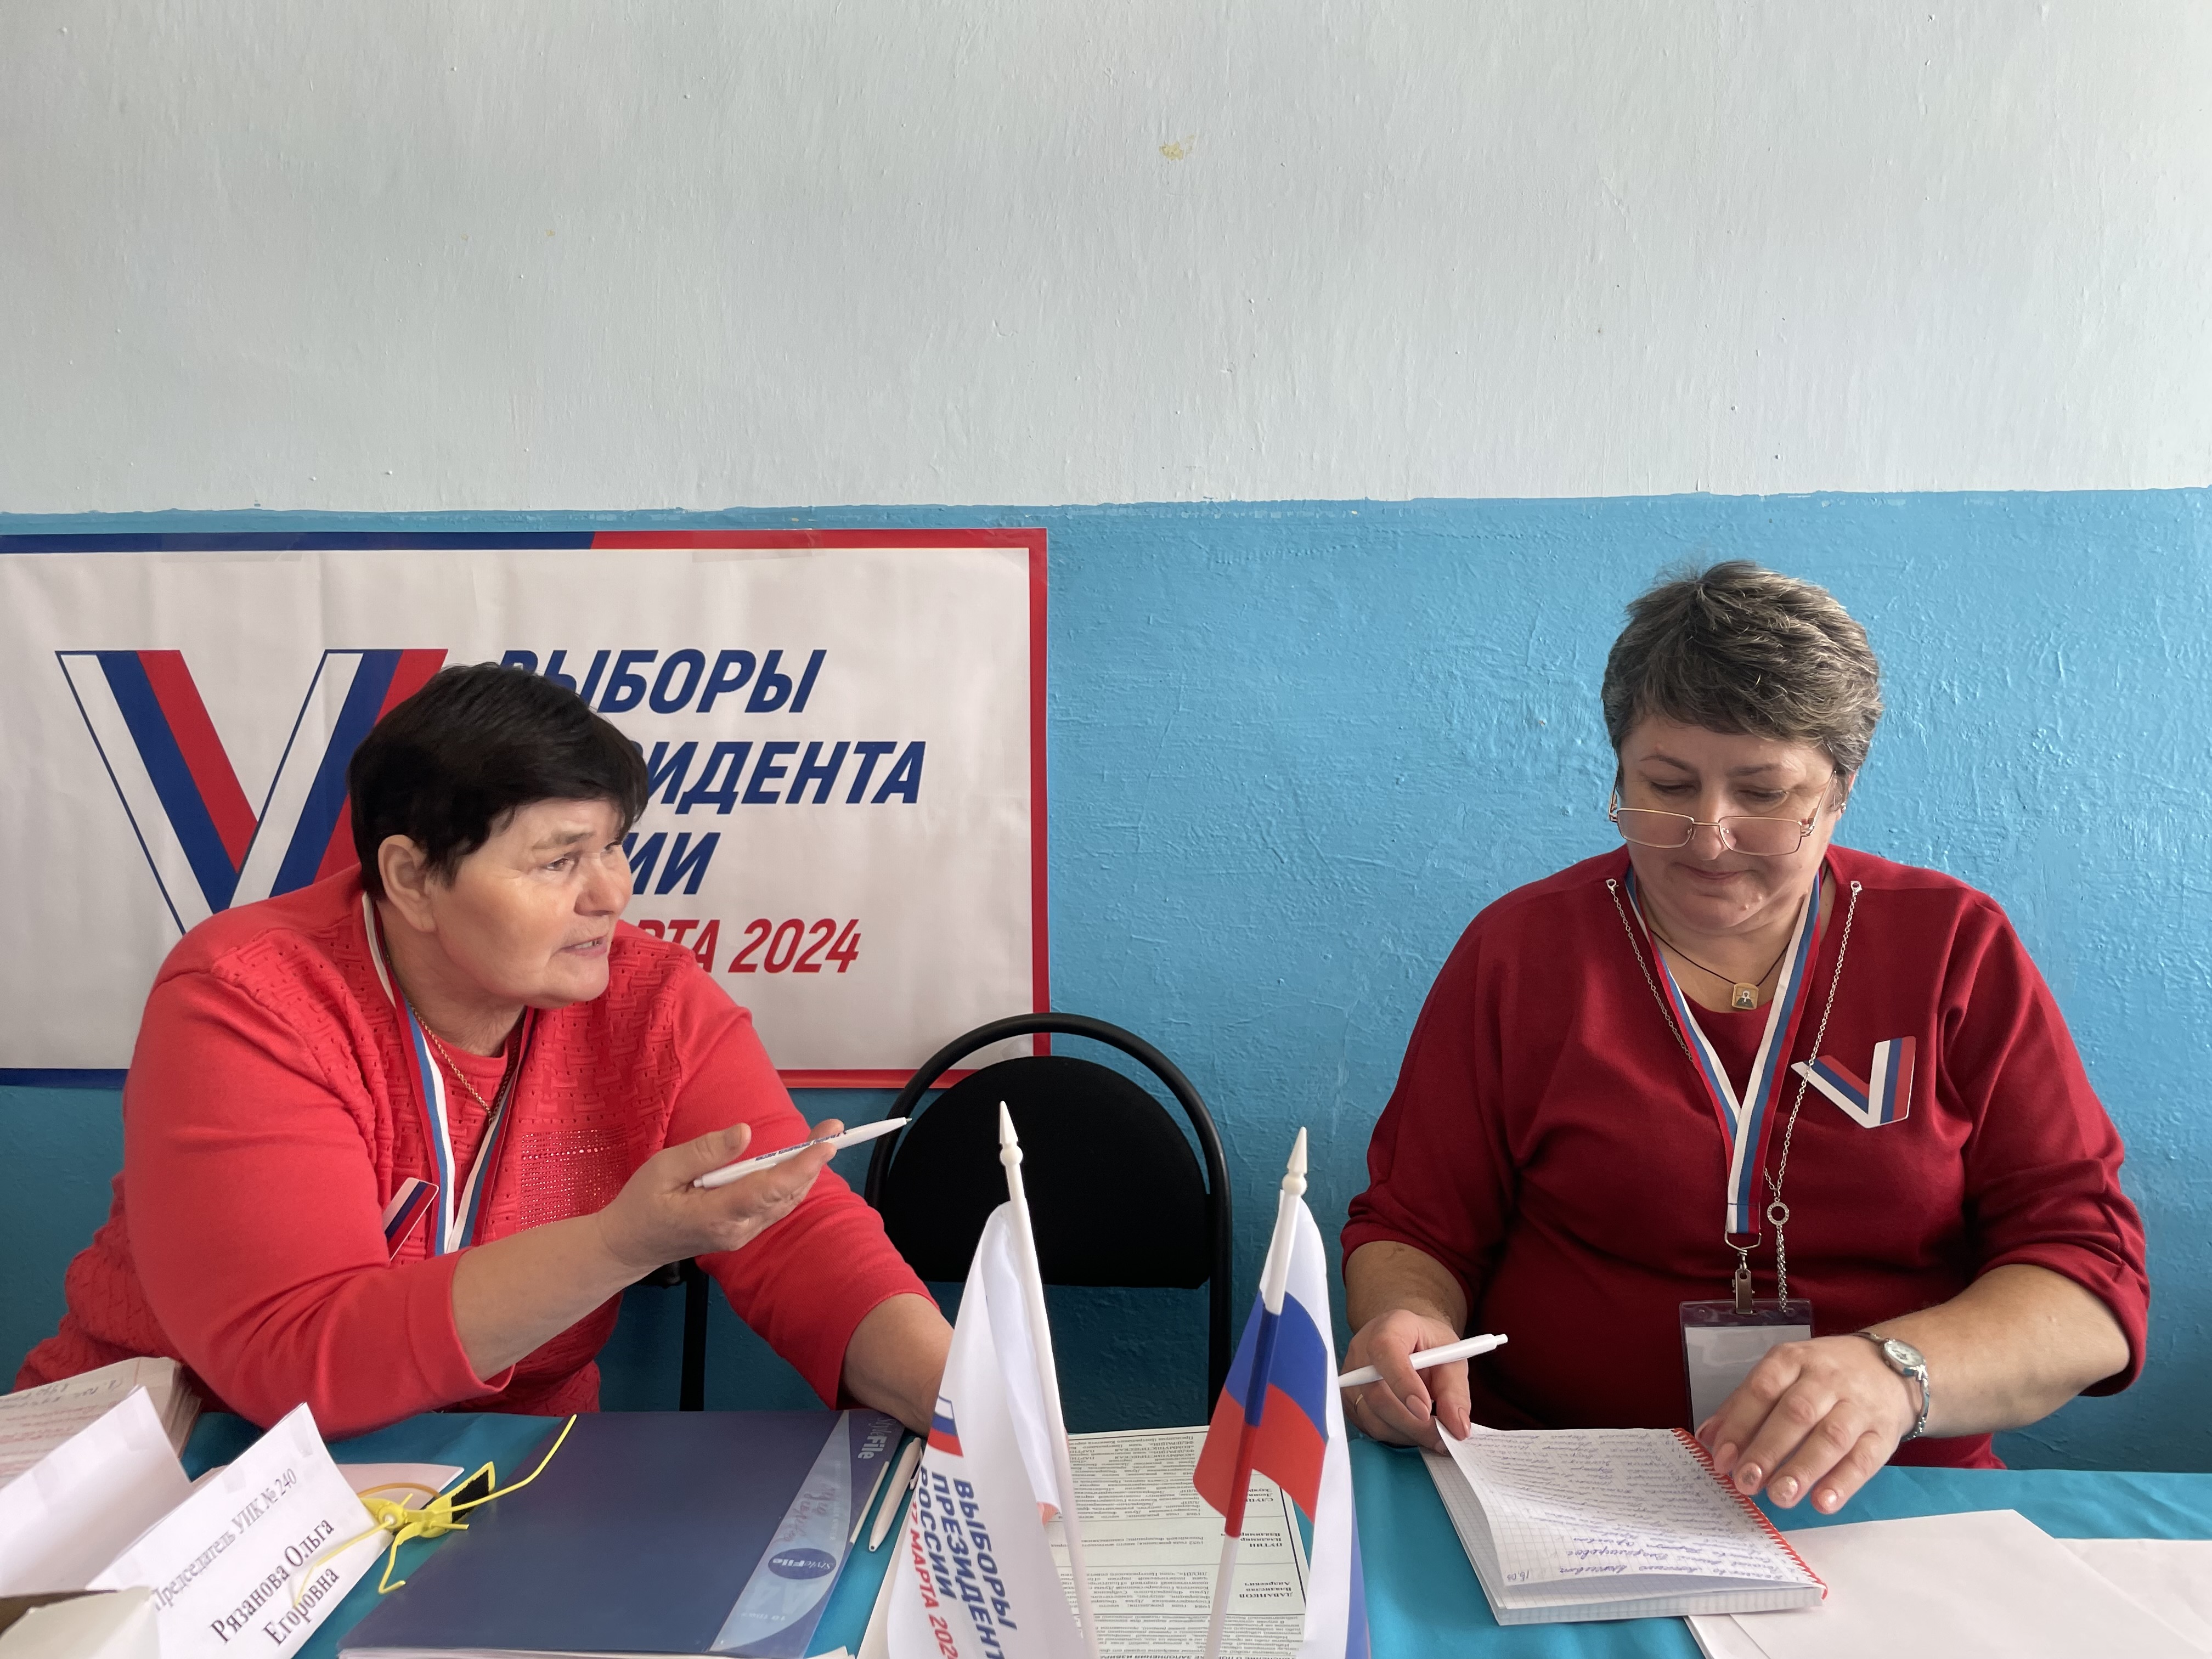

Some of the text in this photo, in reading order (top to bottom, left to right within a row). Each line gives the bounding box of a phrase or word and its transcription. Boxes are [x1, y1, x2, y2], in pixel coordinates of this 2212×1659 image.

[633, 741, 926, 814] ИДЕНТА
[728, 918, 861, 973] 2024
[231, 1498, 265, 1534] УИК
[261, 1488, 279, 1509] №
[274, 1468, 297, 1496] 240
[919, 1465, 957, 1600] РОССИИ
[208, 1519, 334, 1644] Рязанова Ольга
[910, 1528, 940, 1609] МАРТА
[928, 1613, 959, 1659] 202
[953, 1477, 1017, 1630] ВЫБОРЫ
[262, 1568, 340, 1646] Егоровна
